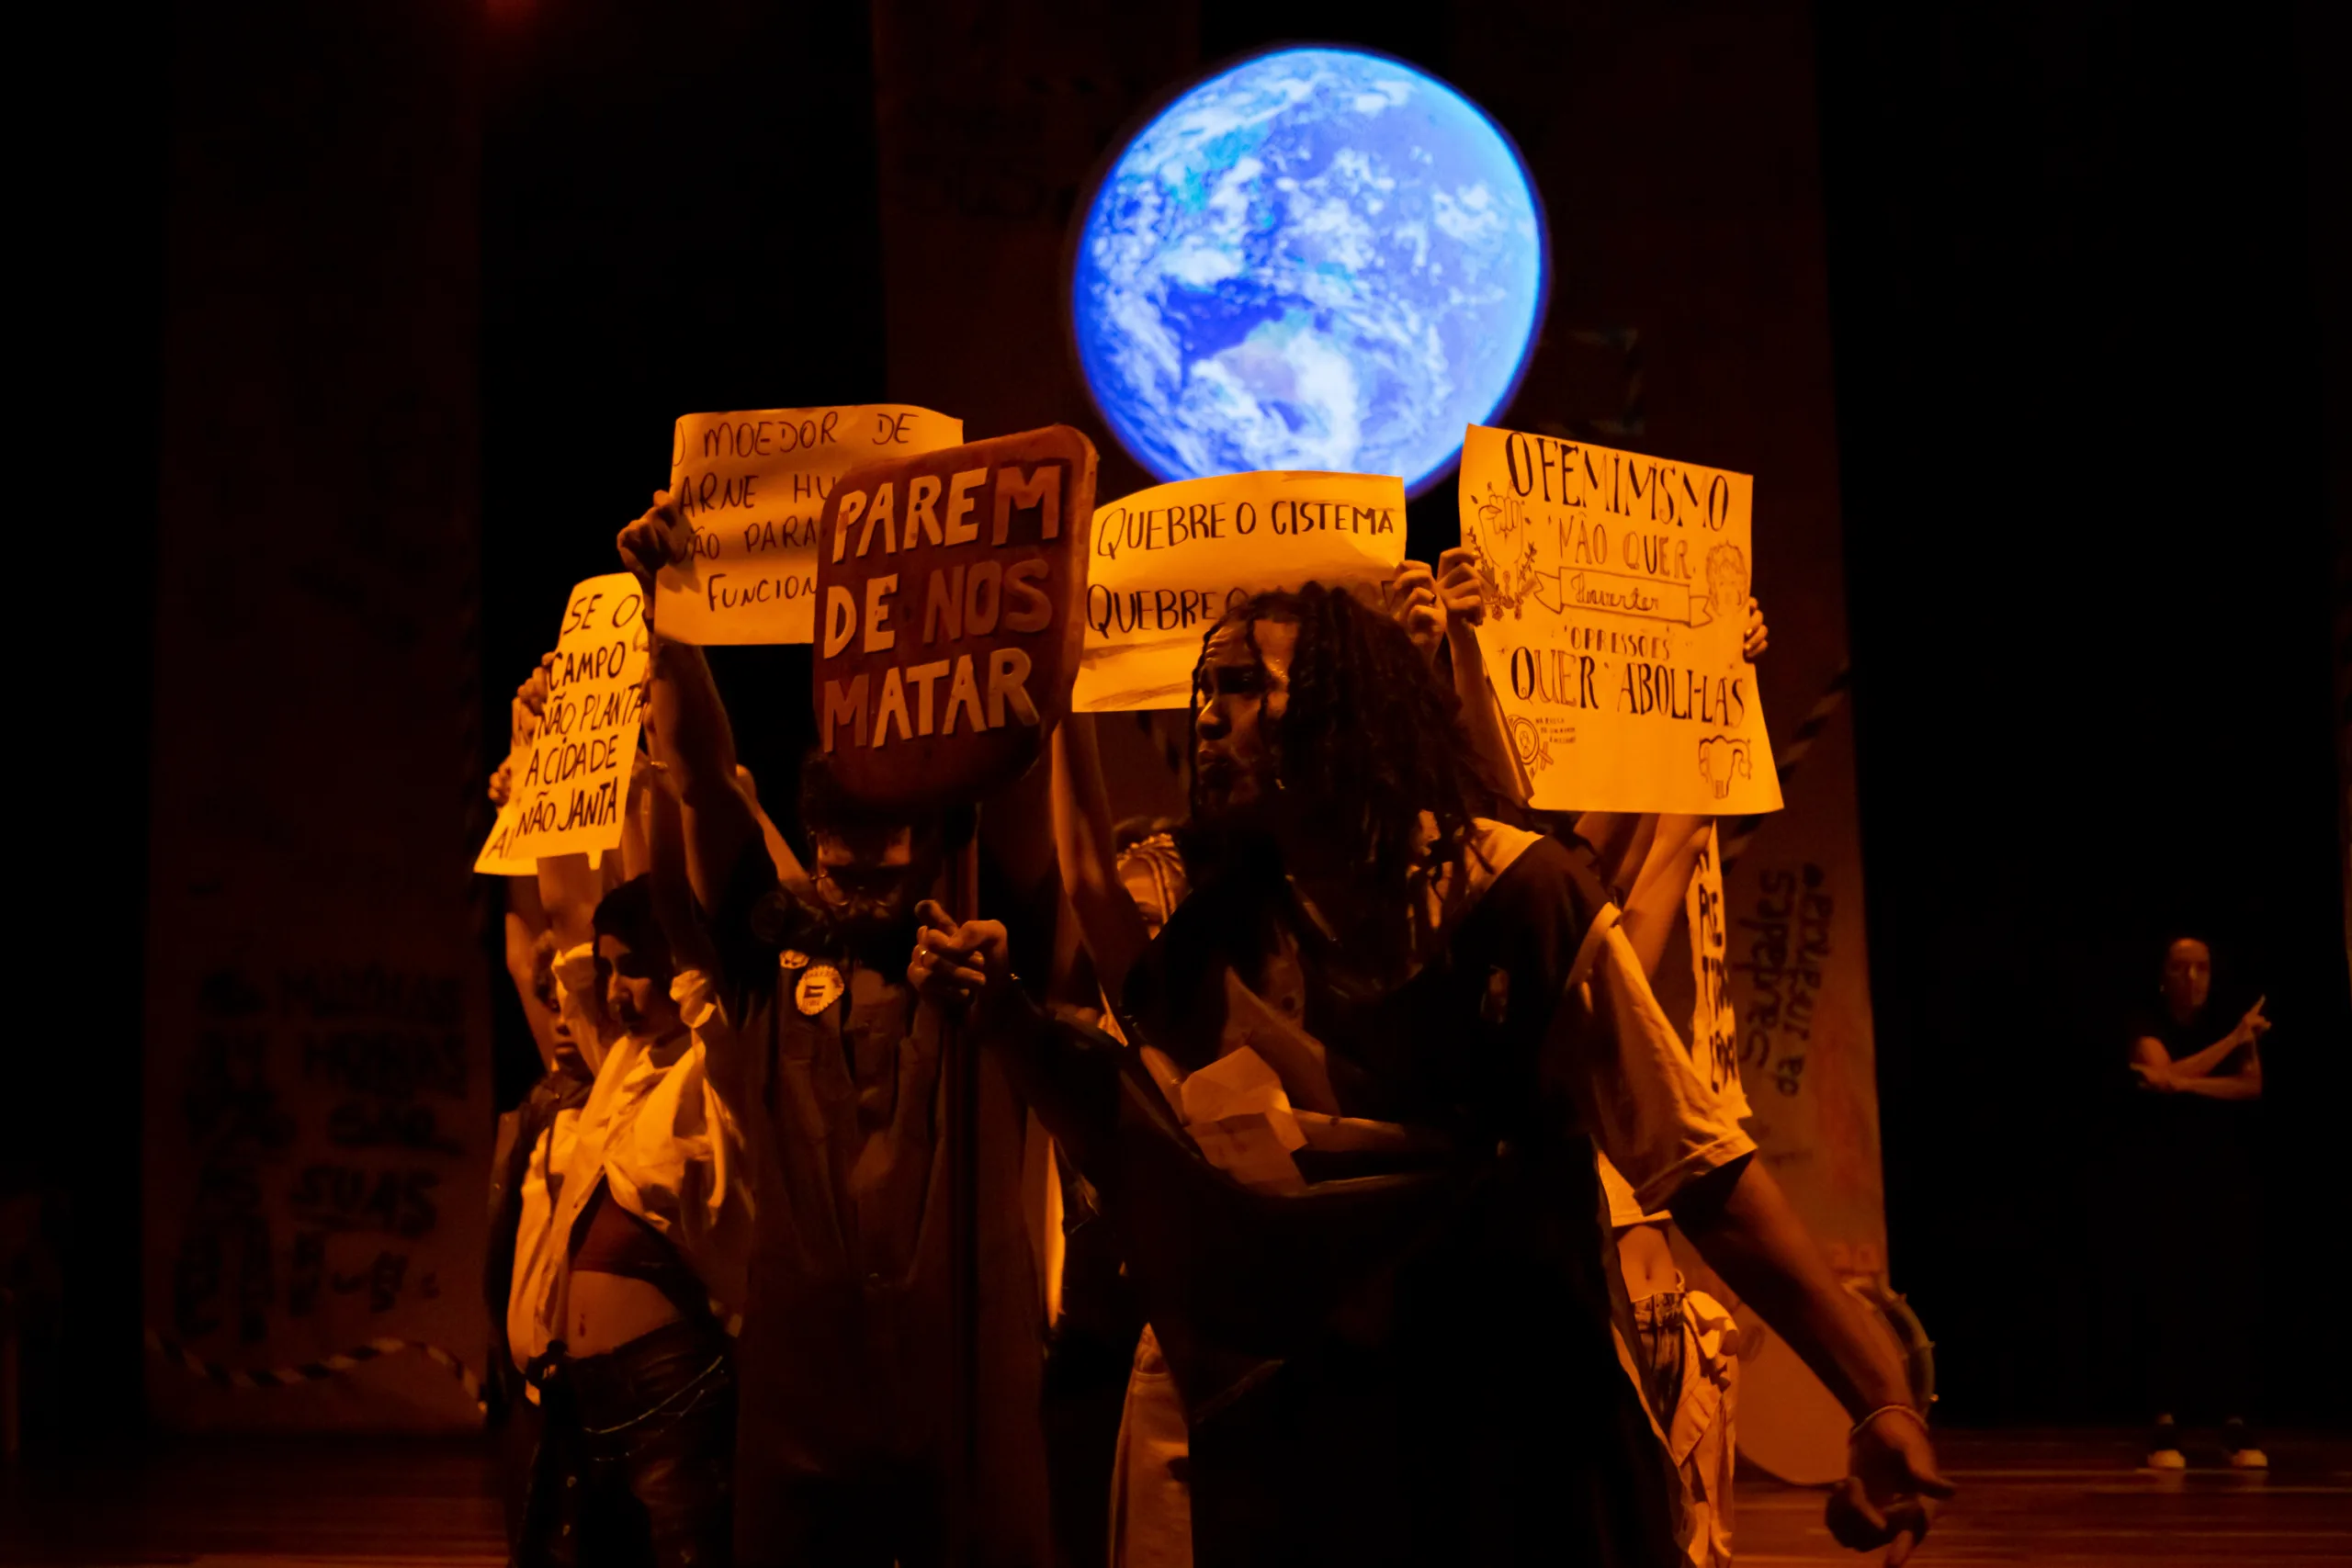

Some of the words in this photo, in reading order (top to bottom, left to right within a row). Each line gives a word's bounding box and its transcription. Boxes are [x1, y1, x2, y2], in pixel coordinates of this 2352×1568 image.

[704, 412, 840, 458] MOEDOR
[872, 413, 920, 446] DE
[672, 472, 760, 518] ARNE
[832, 464, 1062, 566] PAREM
[743, 515, 817, 553] PARA
[1097, 502, 1227, 560] QUEBRE
[1236, 502, 1257, 536] O
[1271, 500, 1395, 536] CISTEMA
[561, 593, 603, 636] SE
[612, 593, 641, 628] O
[707, 573, 817, 612] FUNCION
[822, 573, 899, 660] DE
[922, 558, 1053, 645] NOS
[1086, 583, 1217, 639] QUEBRE
[548, 641, 627, 693] CAMPO
[1510, 646, 1600, 710] QUER
[537, 691, 577, 740] NÃO
[579, 682, 645, 733] PLANTA
[823, 647, 1040, 753] MATAR
[514, 791, 556, 839] NÃO
[557, 776, 618, 832] JANTA
